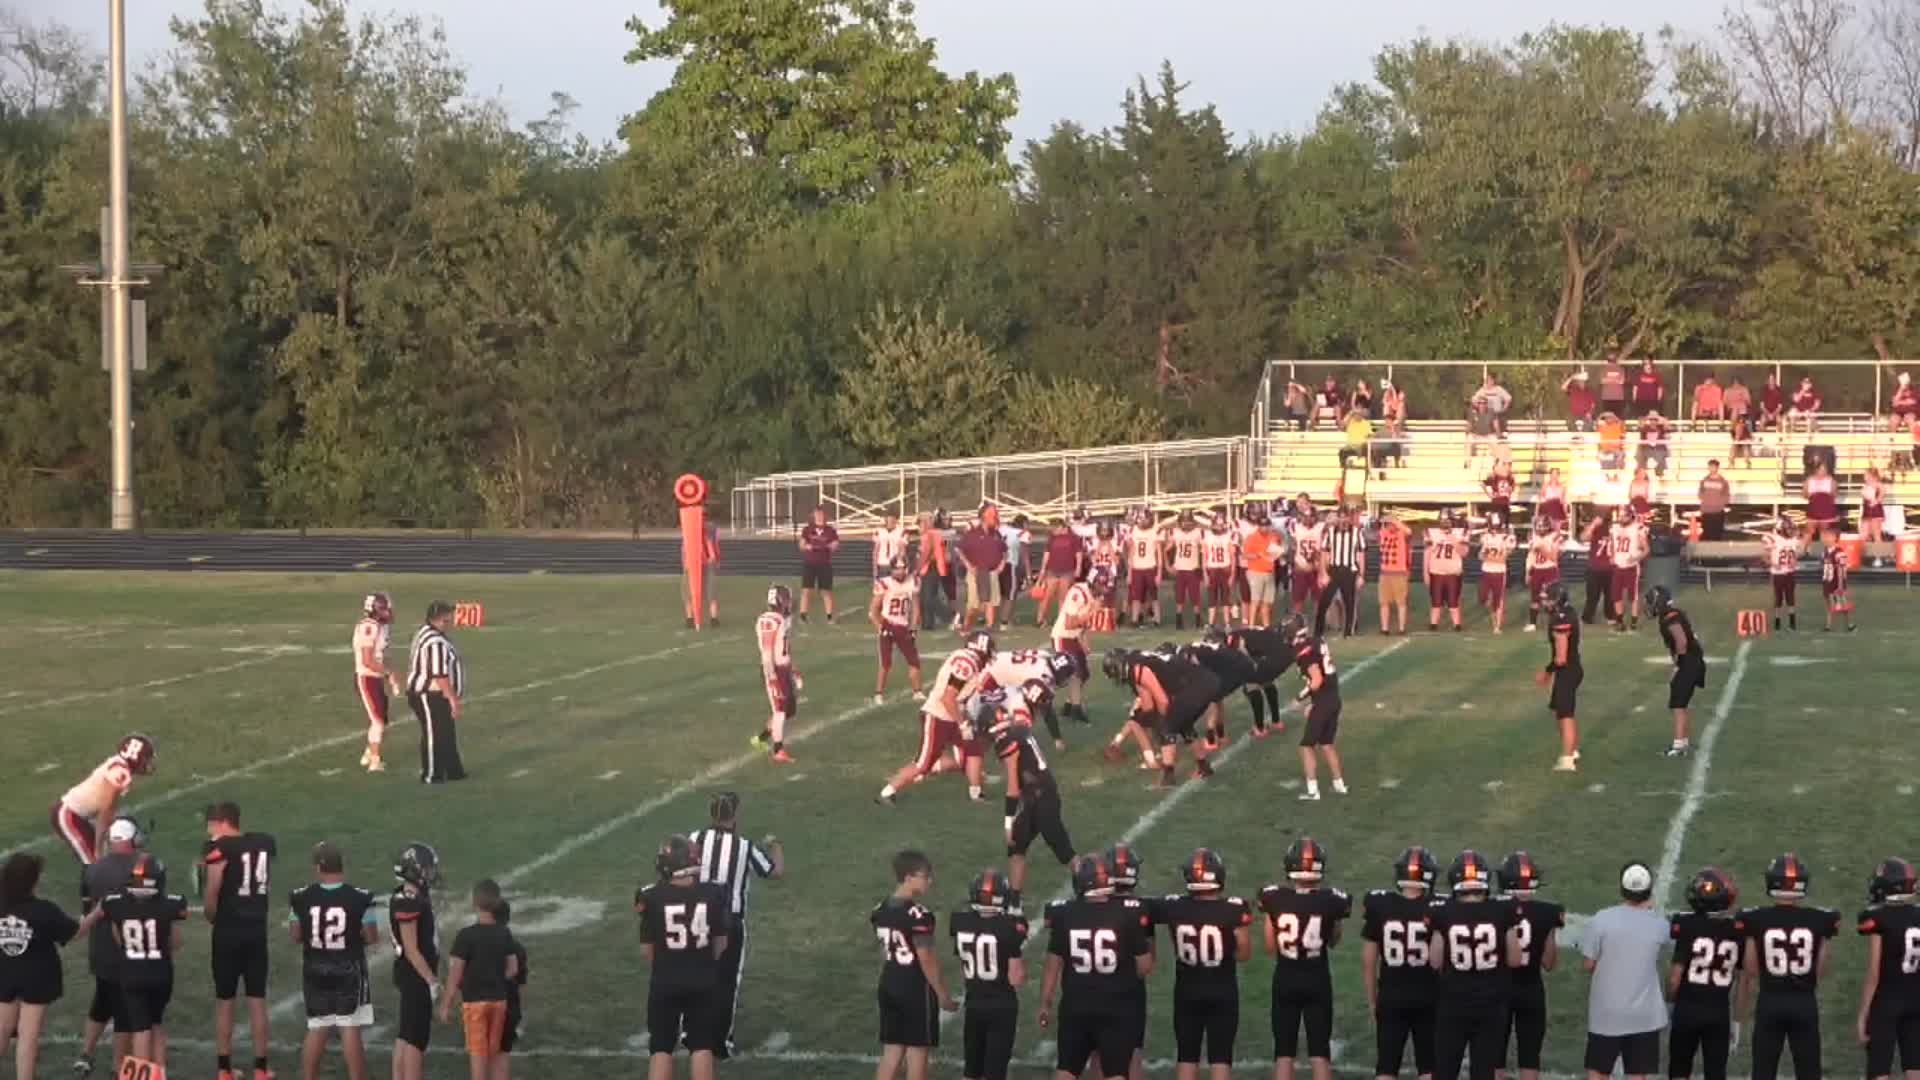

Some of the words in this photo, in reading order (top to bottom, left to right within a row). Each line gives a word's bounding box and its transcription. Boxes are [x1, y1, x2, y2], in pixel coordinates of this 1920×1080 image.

[1741, 612, 1764, 635] 40
[238, 850, 269, 897] 14
[122, 918, 163, 960] 81
[308, 905, 347, 950] 12
[664, 903, 710, 949] 54
[1176, 925, 1224, 967] 60
[1277, 913, 1323, 960] 24
[1383, 920, 1430, 967] 65
[1449, 923, 1498, 971] 62
[956, 932, 1000, 982] 50
[1068, 929, 1118, 974] 56
[1687, 936, 1739, 987] 23
[1763, 928, 1814, 976] 63
